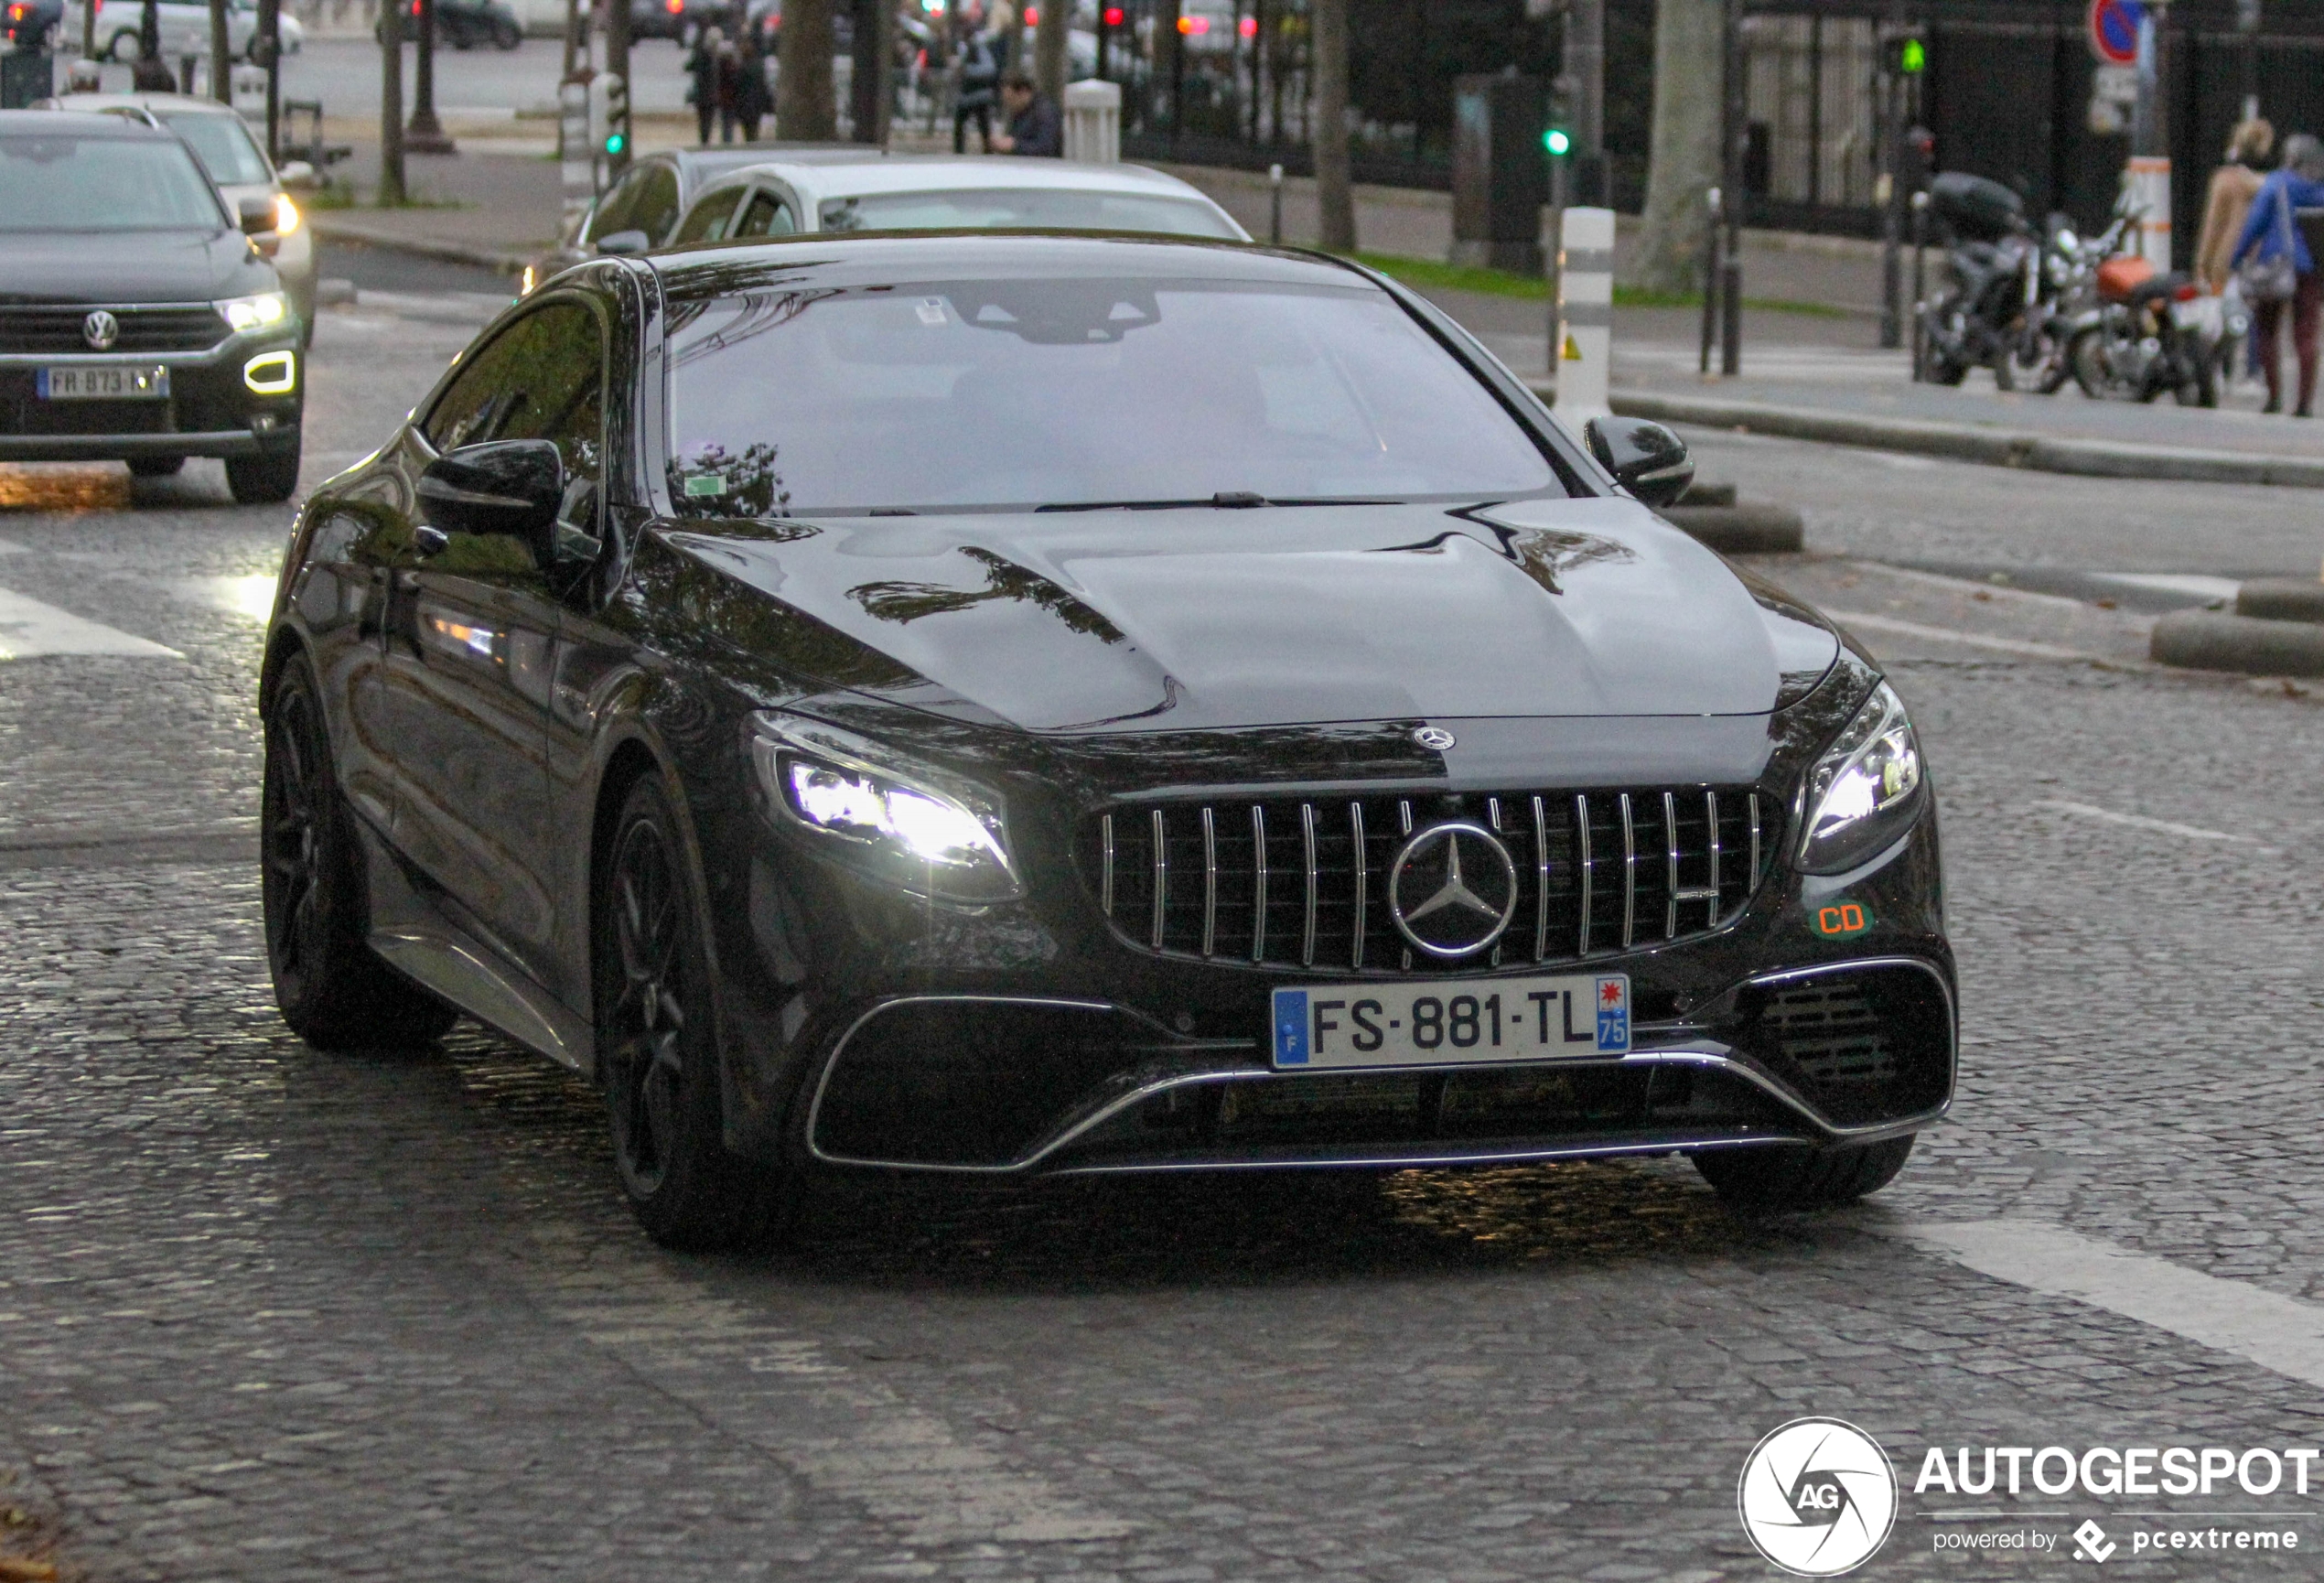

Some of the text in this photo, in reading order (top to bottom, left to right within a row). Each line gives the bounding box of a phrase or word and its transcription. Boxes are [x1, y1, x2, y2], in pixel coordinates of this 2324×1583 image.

[1819, 904, 1865, 934] CD
[1286, 991, 1625, 1055] F FS-881-TL 75
